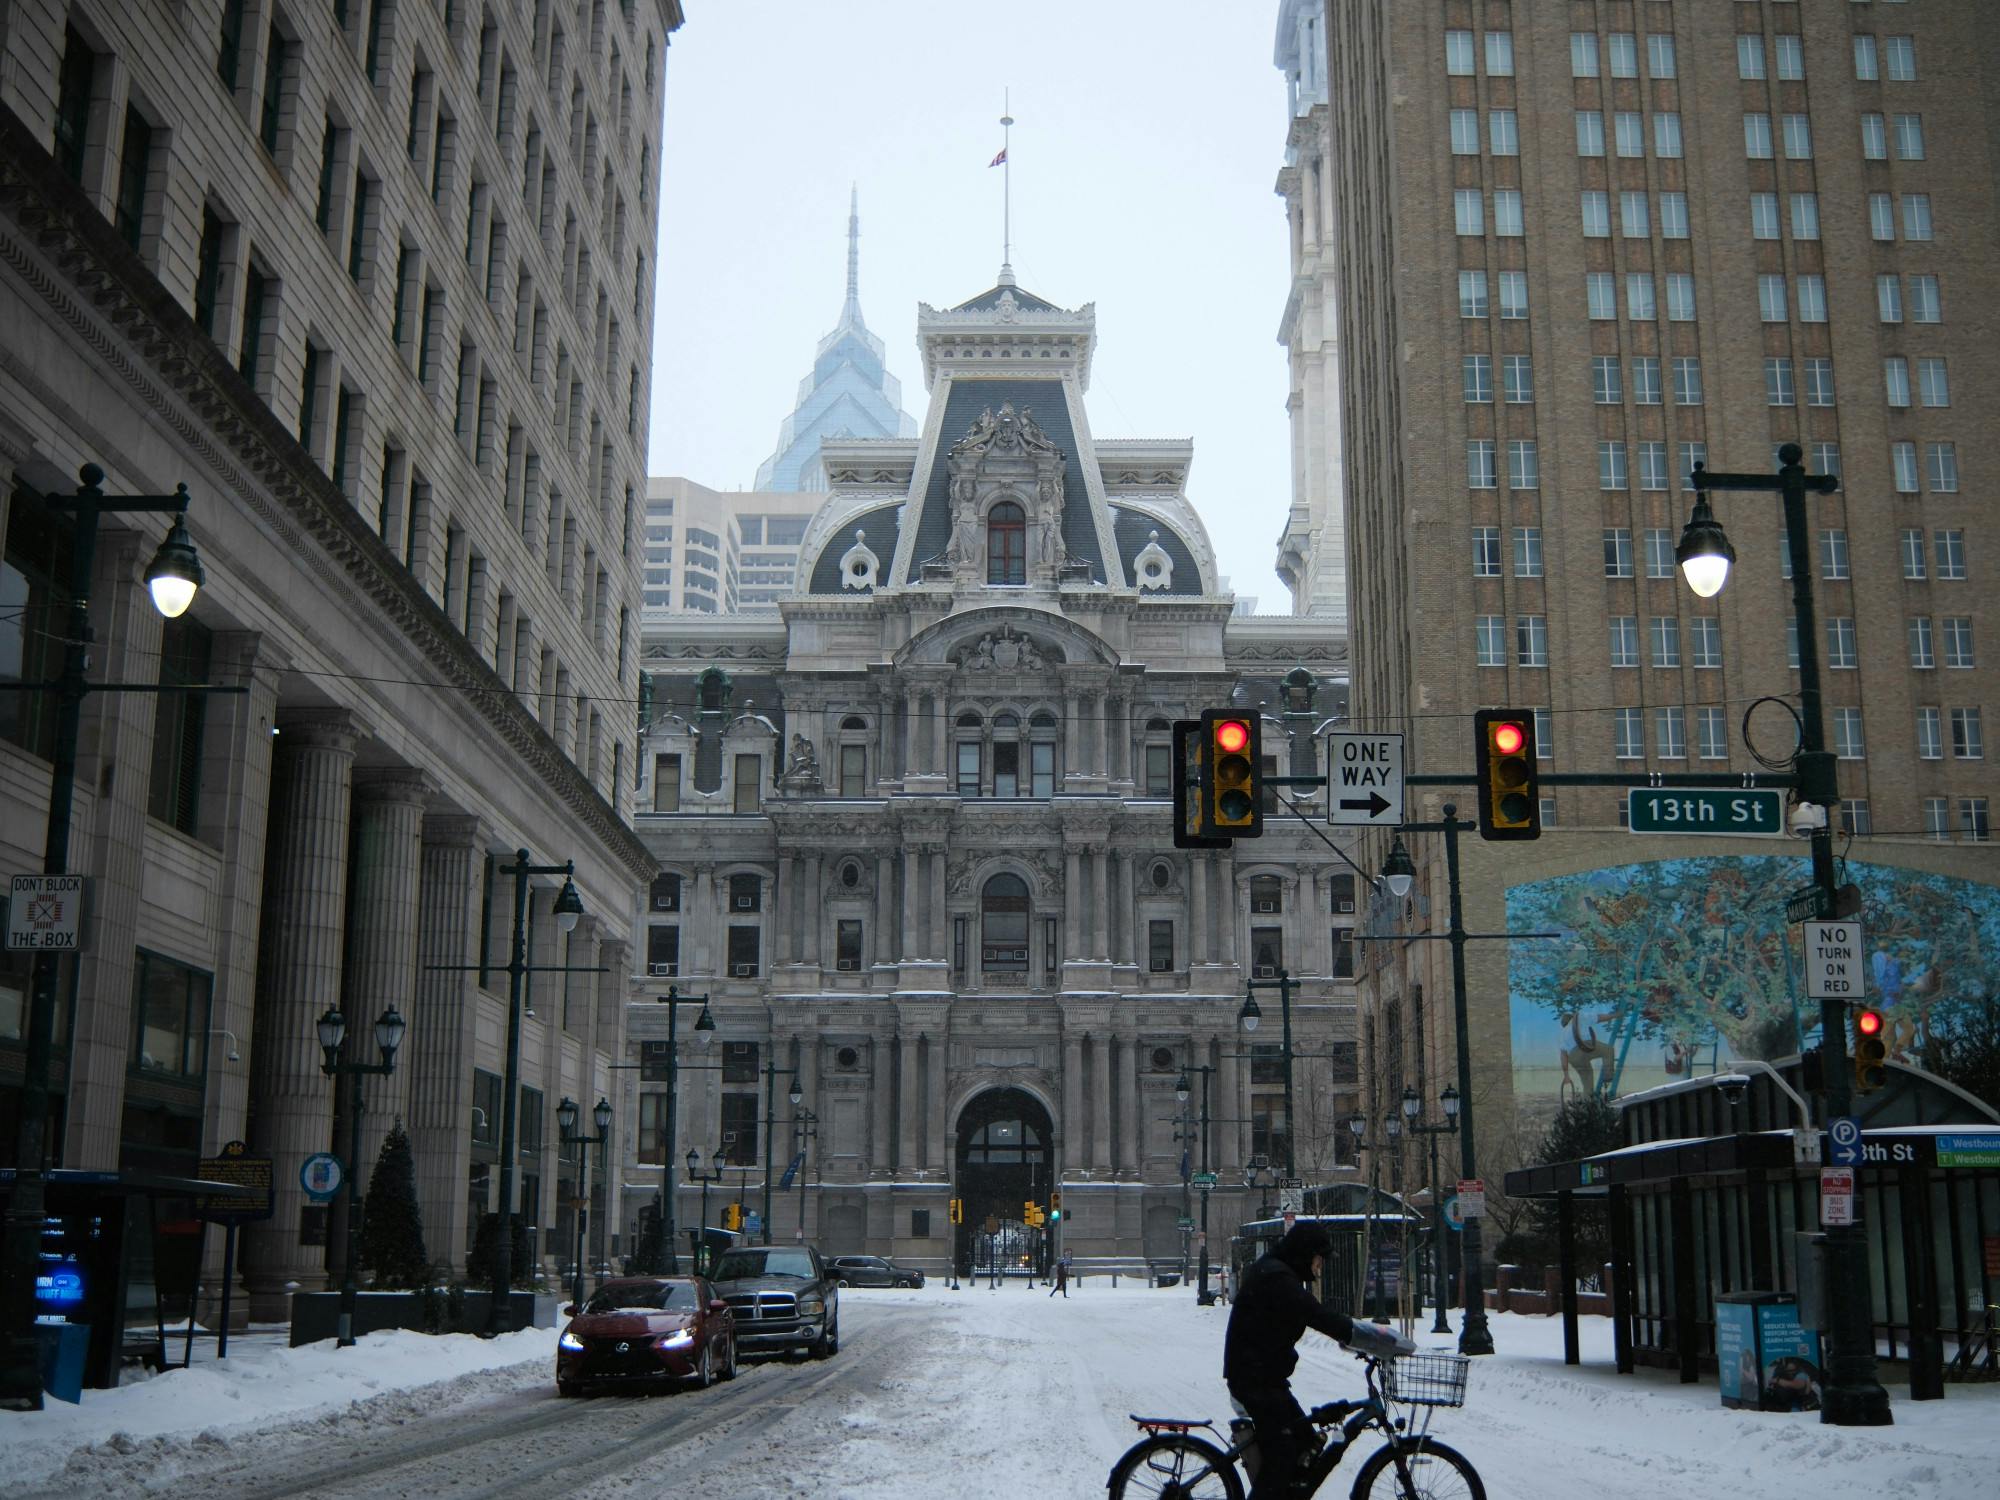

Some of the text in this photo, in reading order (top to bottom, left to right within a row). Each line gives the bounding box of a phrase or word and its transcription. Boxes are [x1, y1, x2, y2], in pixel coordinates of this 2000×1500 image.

[1344, 742, 1390, 762] ONE
[1341, 766, 1392, 786] WAY
[1648, 798, 1764, 822] 13th St
[47, 878, 80, 891] BLOCK
[1788, 897, 1817, 921] MARKET
[12, 932, 74, 946] THE BOX
[1820, 928, 1847, 943] NO
[1817, 947, 1851, 959] TURN
[1826, 963, 1845, 976] ON
[1824, 980, 1850, 992] RED
[1839, 1125, 1851, 1140] P
[1952, 1138, 2000, 1149] Westboun
[1861, 1142, 1915, 1161] 3th St
[1829, 1197, 1844, 1205] BUS
[1827, 1206, 1845, 1215] ZONE
